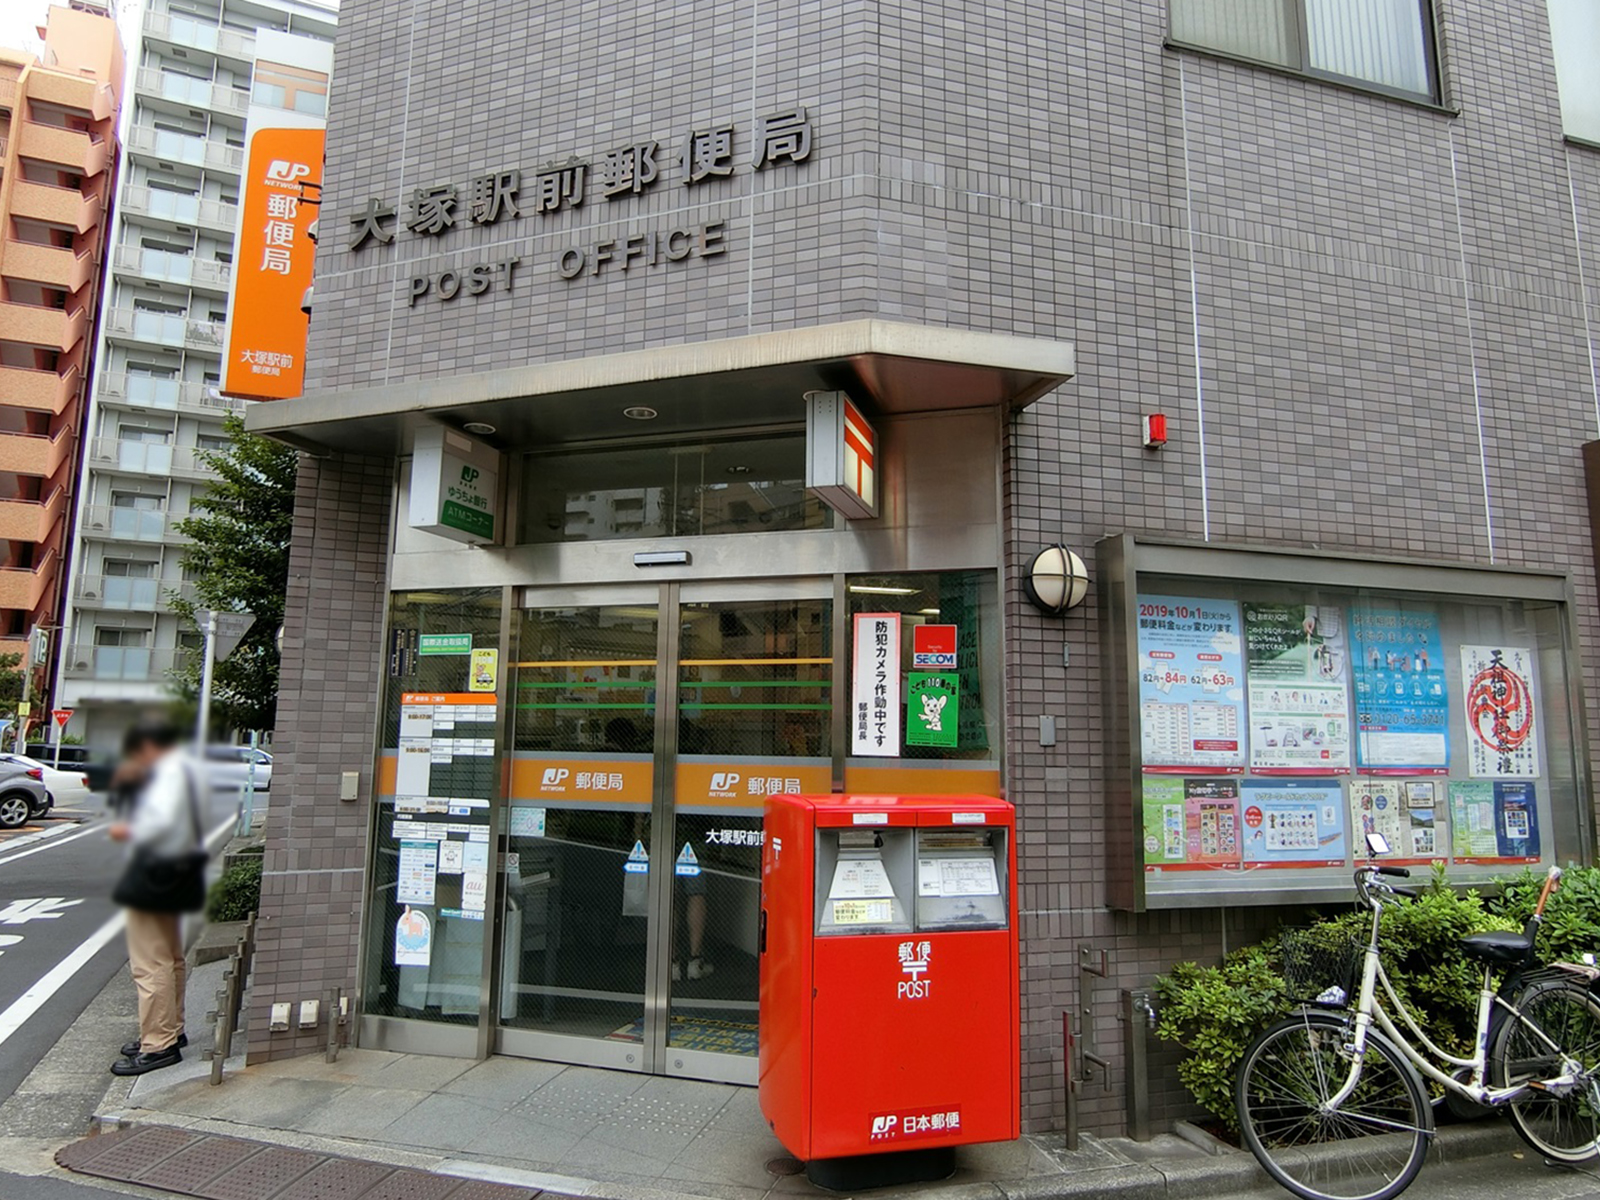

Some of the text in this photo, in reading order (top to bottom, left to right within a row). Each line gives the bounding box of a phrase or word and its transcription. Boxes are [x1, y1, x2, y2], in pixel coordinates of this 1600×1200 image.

[267, 160, 310, 182] JP
[348, 107, 813, 251] 大塚駅前郵便局
[260, 194, 297, 275] 郵便局
[408, 217, 725, 307] POST OFFICE
[241, 349, 293, 368] 大塚駅前
[251, 365, 280, 377] 郵便局
[448, 486, 487, 509] ゆうちょ銀行
[447, 506, 490, 526] ATMコーナー
[916, 654, 954, 664] SECOM
[874, 621, 888, 747] 防犯カメラ作動中です
[1165, 672, 1187, 684] 84円
[1213, 674, 1234, 686] 63円
[858, 702, 868, 740] 郵便局長
[542, 768, 623, 791] JP 郵便局
[710, 773, 801, 795] JP 郵便局
[898, 941, 931, 963] 郵便
[898, 980, 931, 998] POST
[872, 1115, 897, 1134] JP
[903, 1111, 960, 1133] 日本郵便
